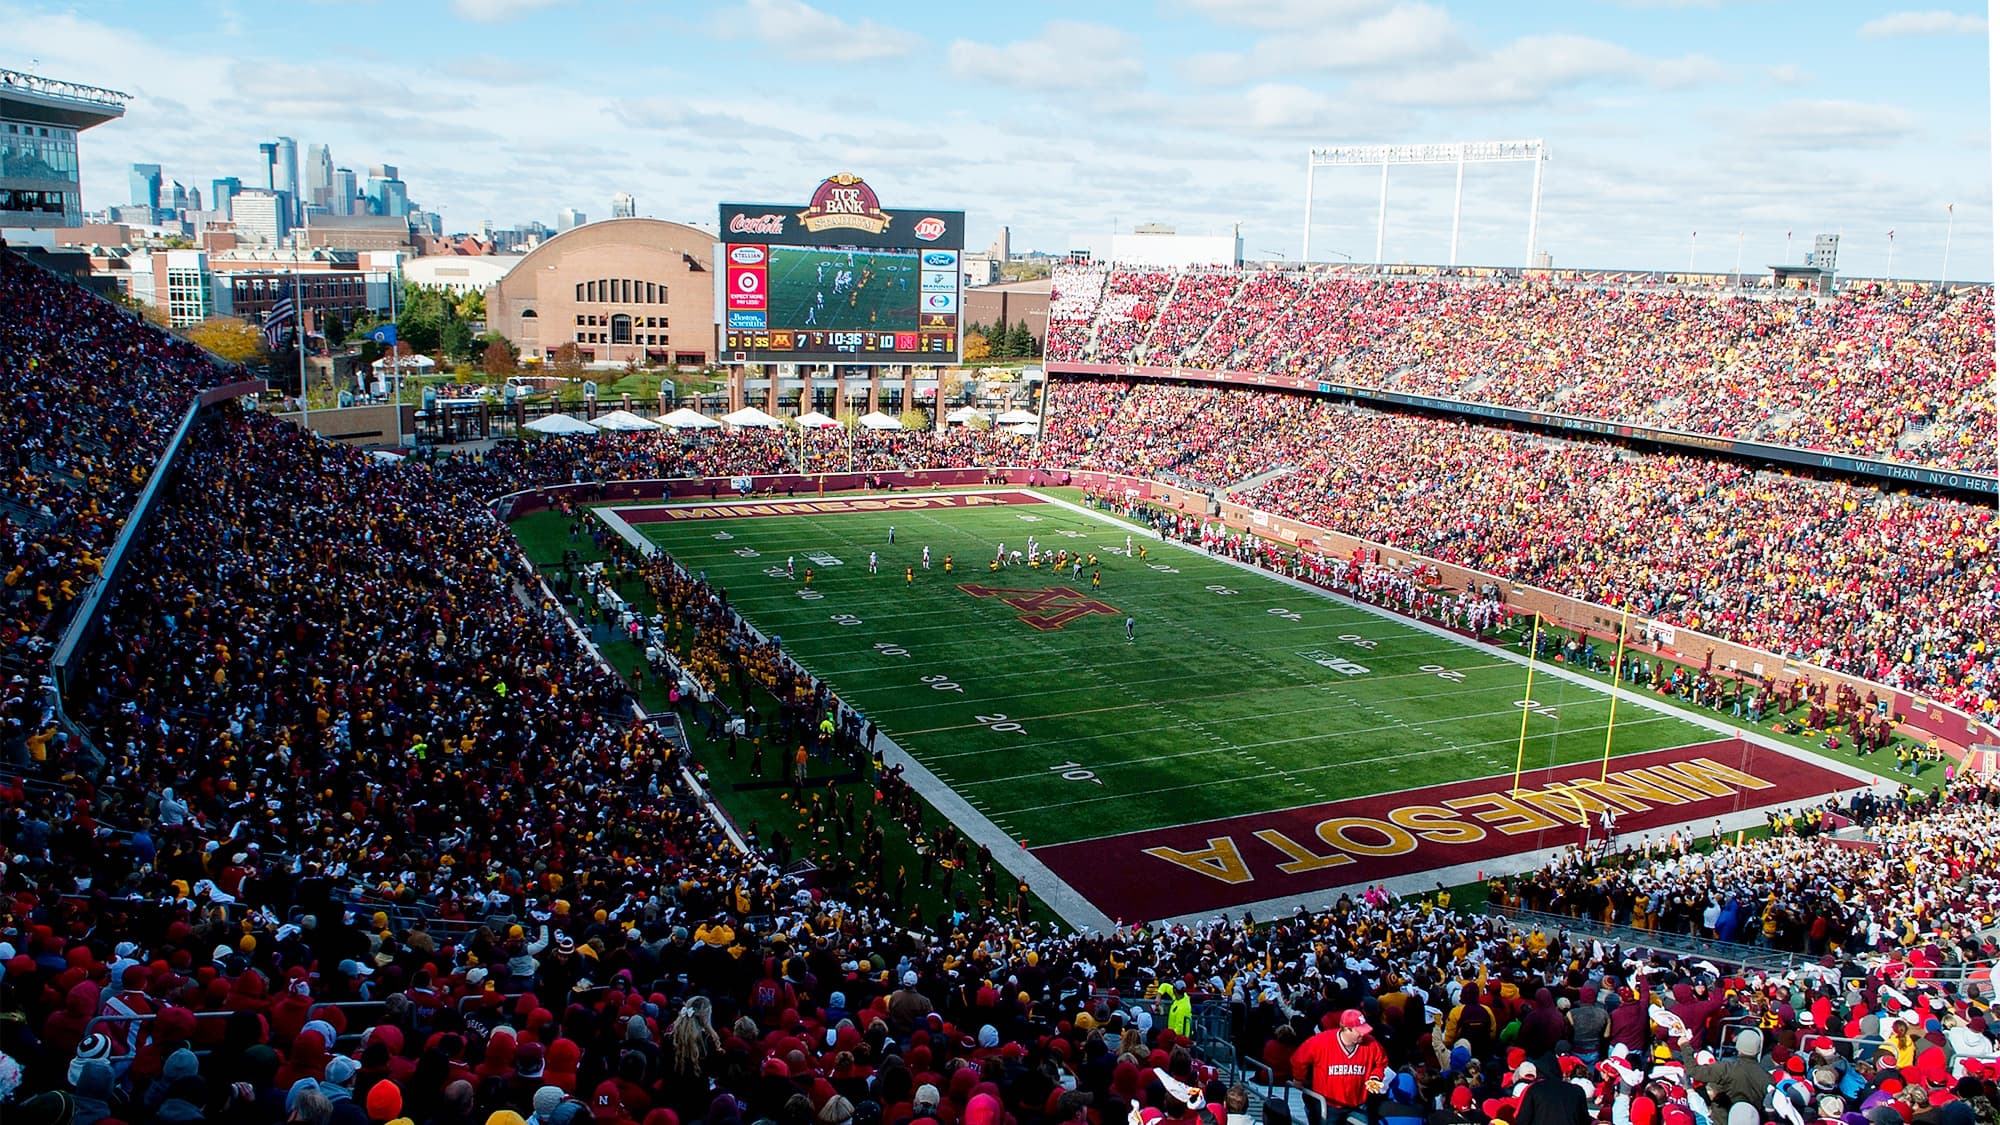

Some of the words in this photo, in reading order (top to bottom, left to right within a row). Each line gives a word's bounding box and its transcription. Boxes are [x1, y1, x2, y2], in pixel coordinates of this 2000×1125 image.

[831, 188, 860, 201] TCF
[825, 200, 865, 214] BANK
[729, 213, 787, 235] Coca-Cola
[814, 216, 876, 231] STADIUM
[921, 223, 941, 235] DQ
[928, 255, 950, 265] Ford
[729, 317, 766, 327] Scientific
[733, 312, 758, 321] Boston
[728, 336, 737, 347] 3
[743, 336, 752, 348] 3
[797, 334, 807, 348] 7
[828, 332, 863, 345] 10:36
[879, 335, 894, 348] 10
[1822, 456, 1833, 467] M
[1886, 465, 1918, 480] THAN
[1964, 478, 1989, 491] HER
[665, 494, 1008, 520] MINNESOTA
[830, 614, 864, 626] 50
[1338, 634, 1379, 649] 30
[873, 642, 906, 657] 40
[1418, 664, 1467, 680] 20
[920, 674, 957, 691] 30
[974, 713, 1021, 732] 20
[1049, 760, 1095, 782] 10
[1143, 758, 1777, 885] MINNESOTA
[599, 1095, 609, 1105] N
